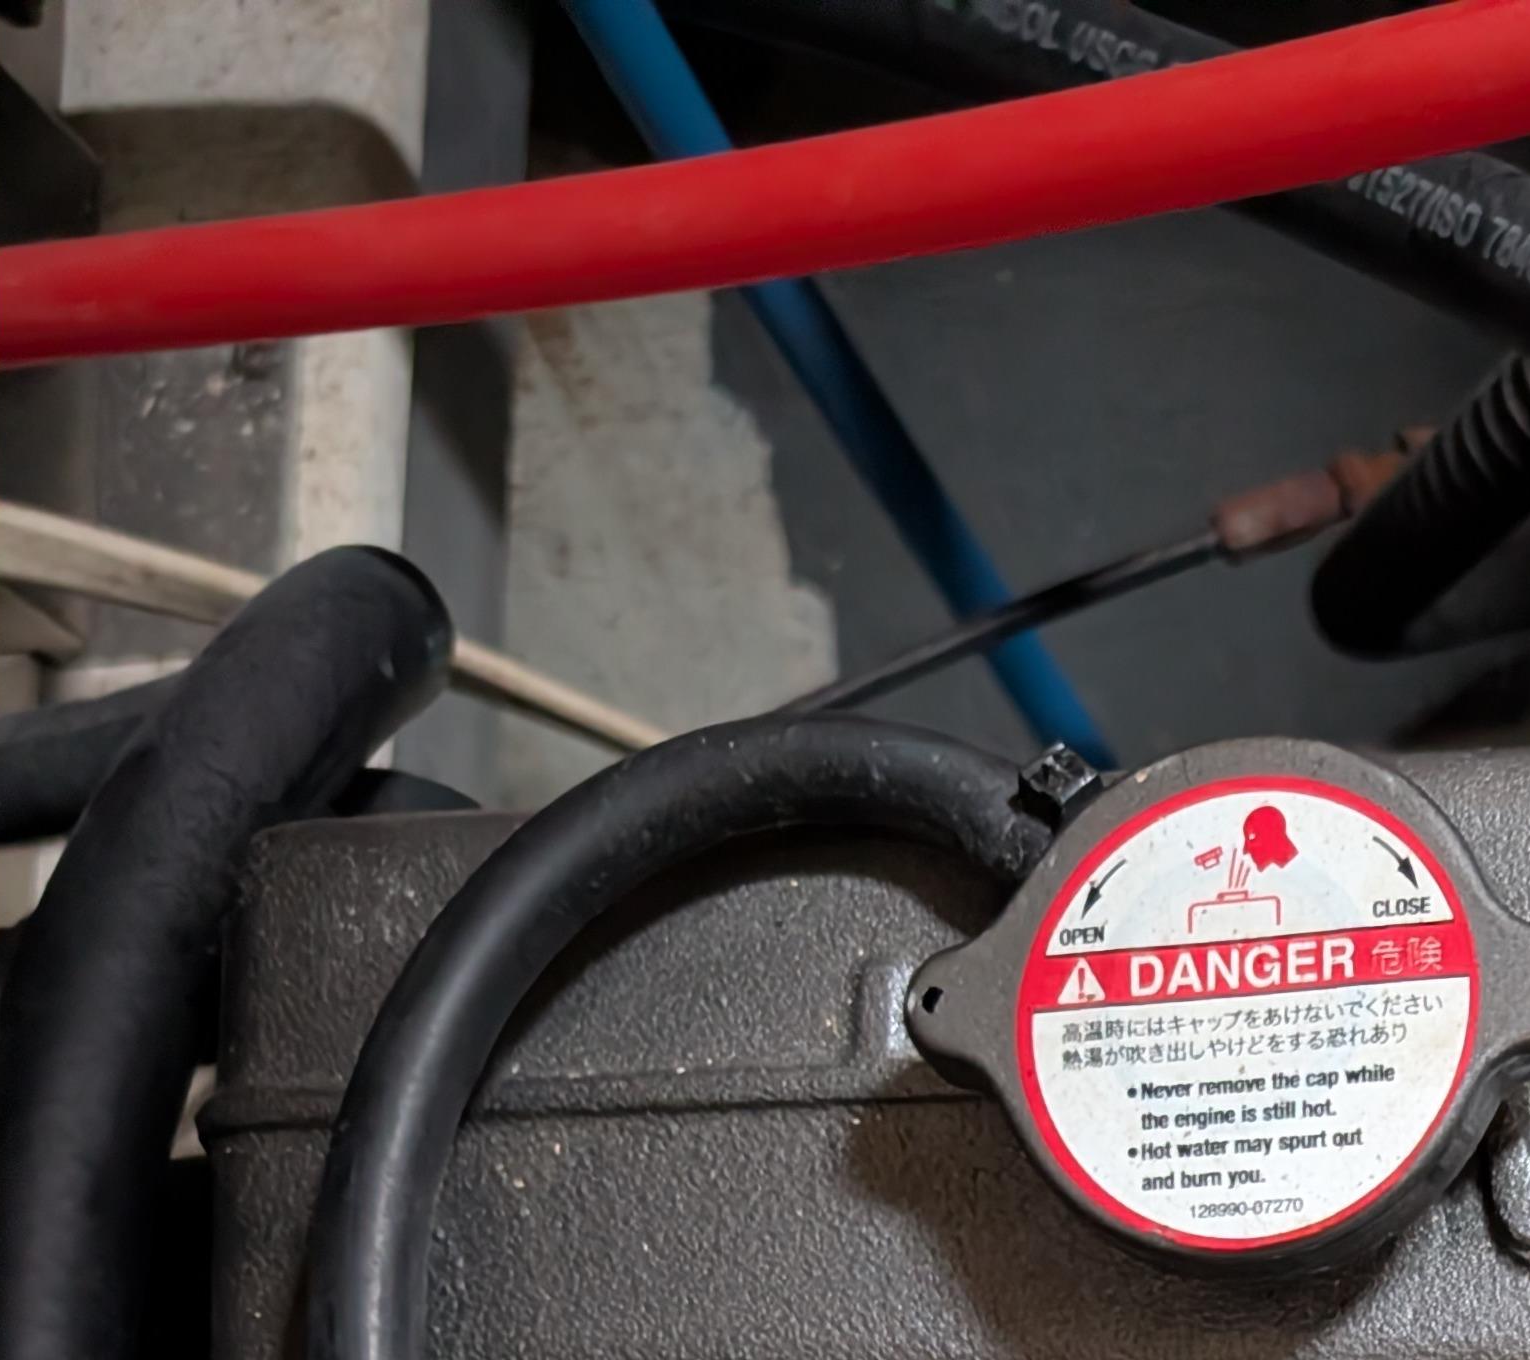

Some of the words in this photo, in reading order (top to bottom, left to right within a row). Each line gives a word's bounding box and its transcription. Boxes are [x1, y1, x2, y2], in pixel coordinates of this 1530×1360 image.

[1372, 897, 1432, 918] CLOSE
[1059, 927, 1106, 946] OPEN
[1129, 936, 1355, 997] DANGER
[1371, 936, 1443, 975] 危険
[1141, 1082, 1191, 1099] Never
[1198, 1076, 1266, 1095] remove
[1272, 1073, 1300, 1089] the
[1305, 1070, 1339, 1090] cap
[1345, 1064, 1395, 1083] while
[1141, 1112, 1168, 1130] the
[1175, 1108, 1236, 1130] engine
[1241, 1106, 1257, 1123] is
[1262, 1101, 1296, 1120] still
[1302, 1099, 1337, 1118] hot.
[1141, 1143, 1171, 1161] Hot
[1176, 1138, 1228, 1157] water
[1234, 1137, 1273, 1157] may
[1278, 1132, 1327, 1154] spurt
[1332, 1128, 1363, 1146] out
[1141, 1172, 1175, 1191] and
[1180, 1170, 1221, 1189] burn
[1228, 1169, 1266, 1188] you.
